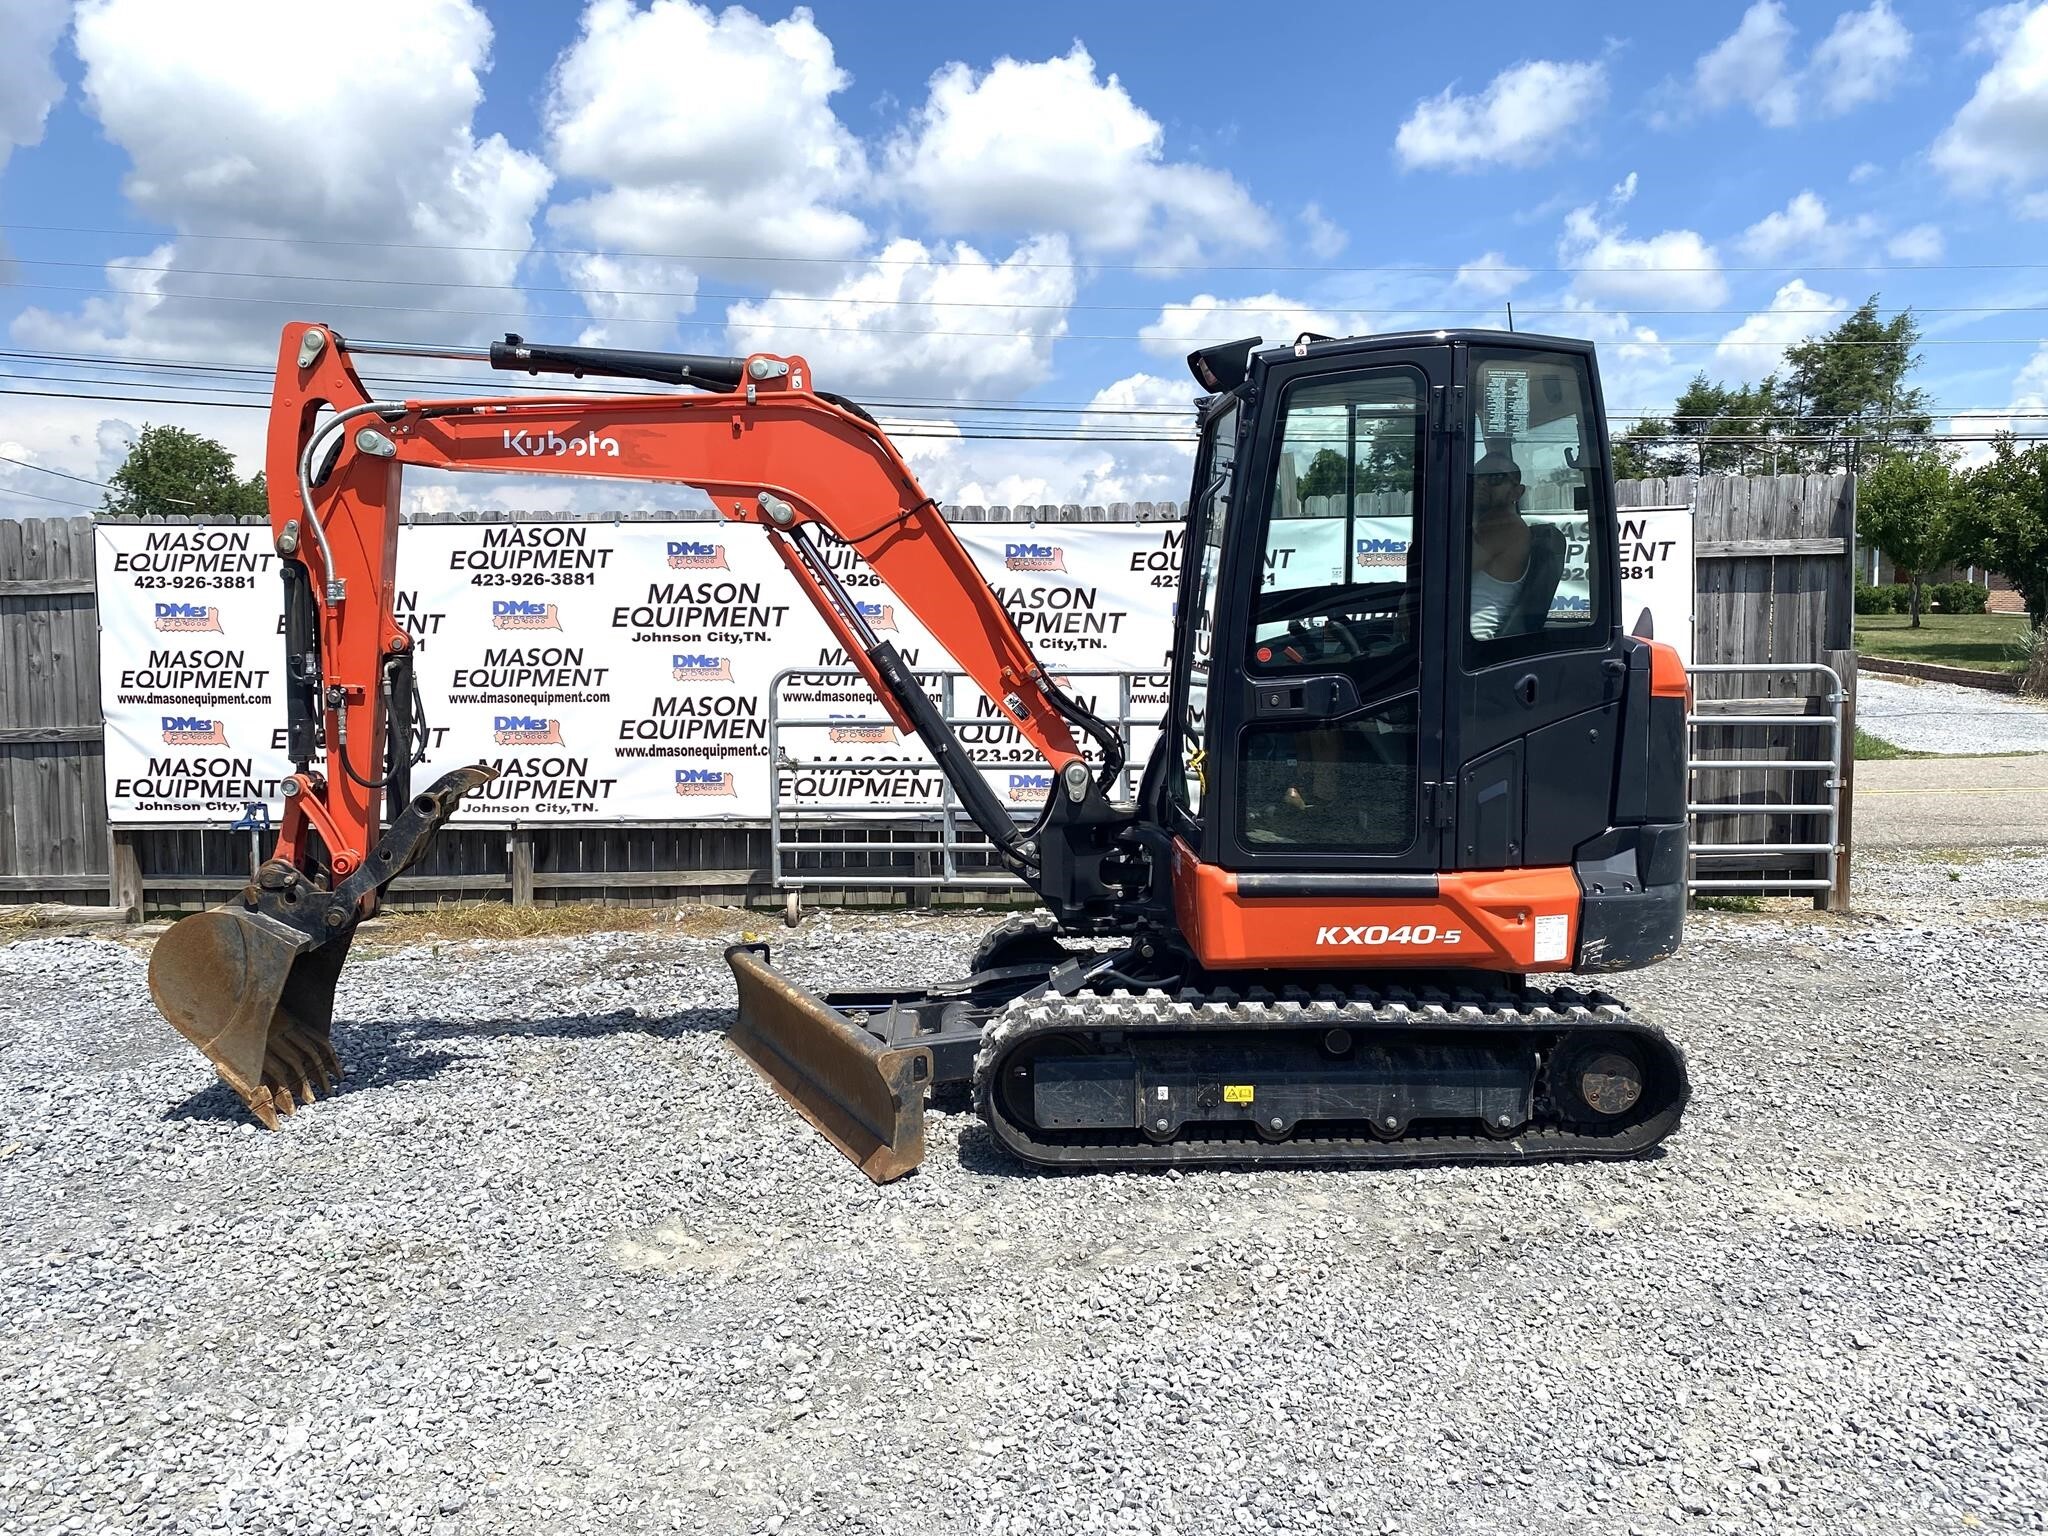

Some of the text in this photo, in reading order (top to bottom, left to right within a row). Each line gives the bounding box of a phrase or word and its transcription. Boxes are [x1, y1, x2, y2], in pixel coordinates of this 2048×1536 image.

[503, 429, 620, 457] Kubota
[145, 532, 250, 551] MASON
[483, 528, 586, 548] MASON
[114, 553, 275, 572] EQUIPMENT
[450, 549, 614, 570] EQUIPMENT
[133, 576, 255, 589] 423-926-3881
[471, 573, 595, 586] 423-926-3881
[647, 583, 761, 604] MASON
[612, 606, 789, 628] EQUIPMENT
[632, 632, 772, 644] Johnson City,TN.
[1040, 638, 1107, 652] City,TN.
[148, 650, 244, 668] MASON
[483, 648, 584, 667] MASON
[120, 670, 269, 689] EQUIPMENT
[452, 668, 609, 688] EQUIPMENT
[117, 693, 272, 707] www.dmasonequipment.com
[449, 691, 610, 706] www.dmasonequipment.com
[652, 696, 757, 717] MASON
[619, 719, 770, 740] EQUIPMEN
[147, 758, 252, 777] MASON
[114, 779, 283, 798] EQUIPMENT
[135, 801, 200, 811] Johnson
[462, 802, 599, 815] Johnson City,TN.
[1314, 925, 1463, 947] KX040-5
